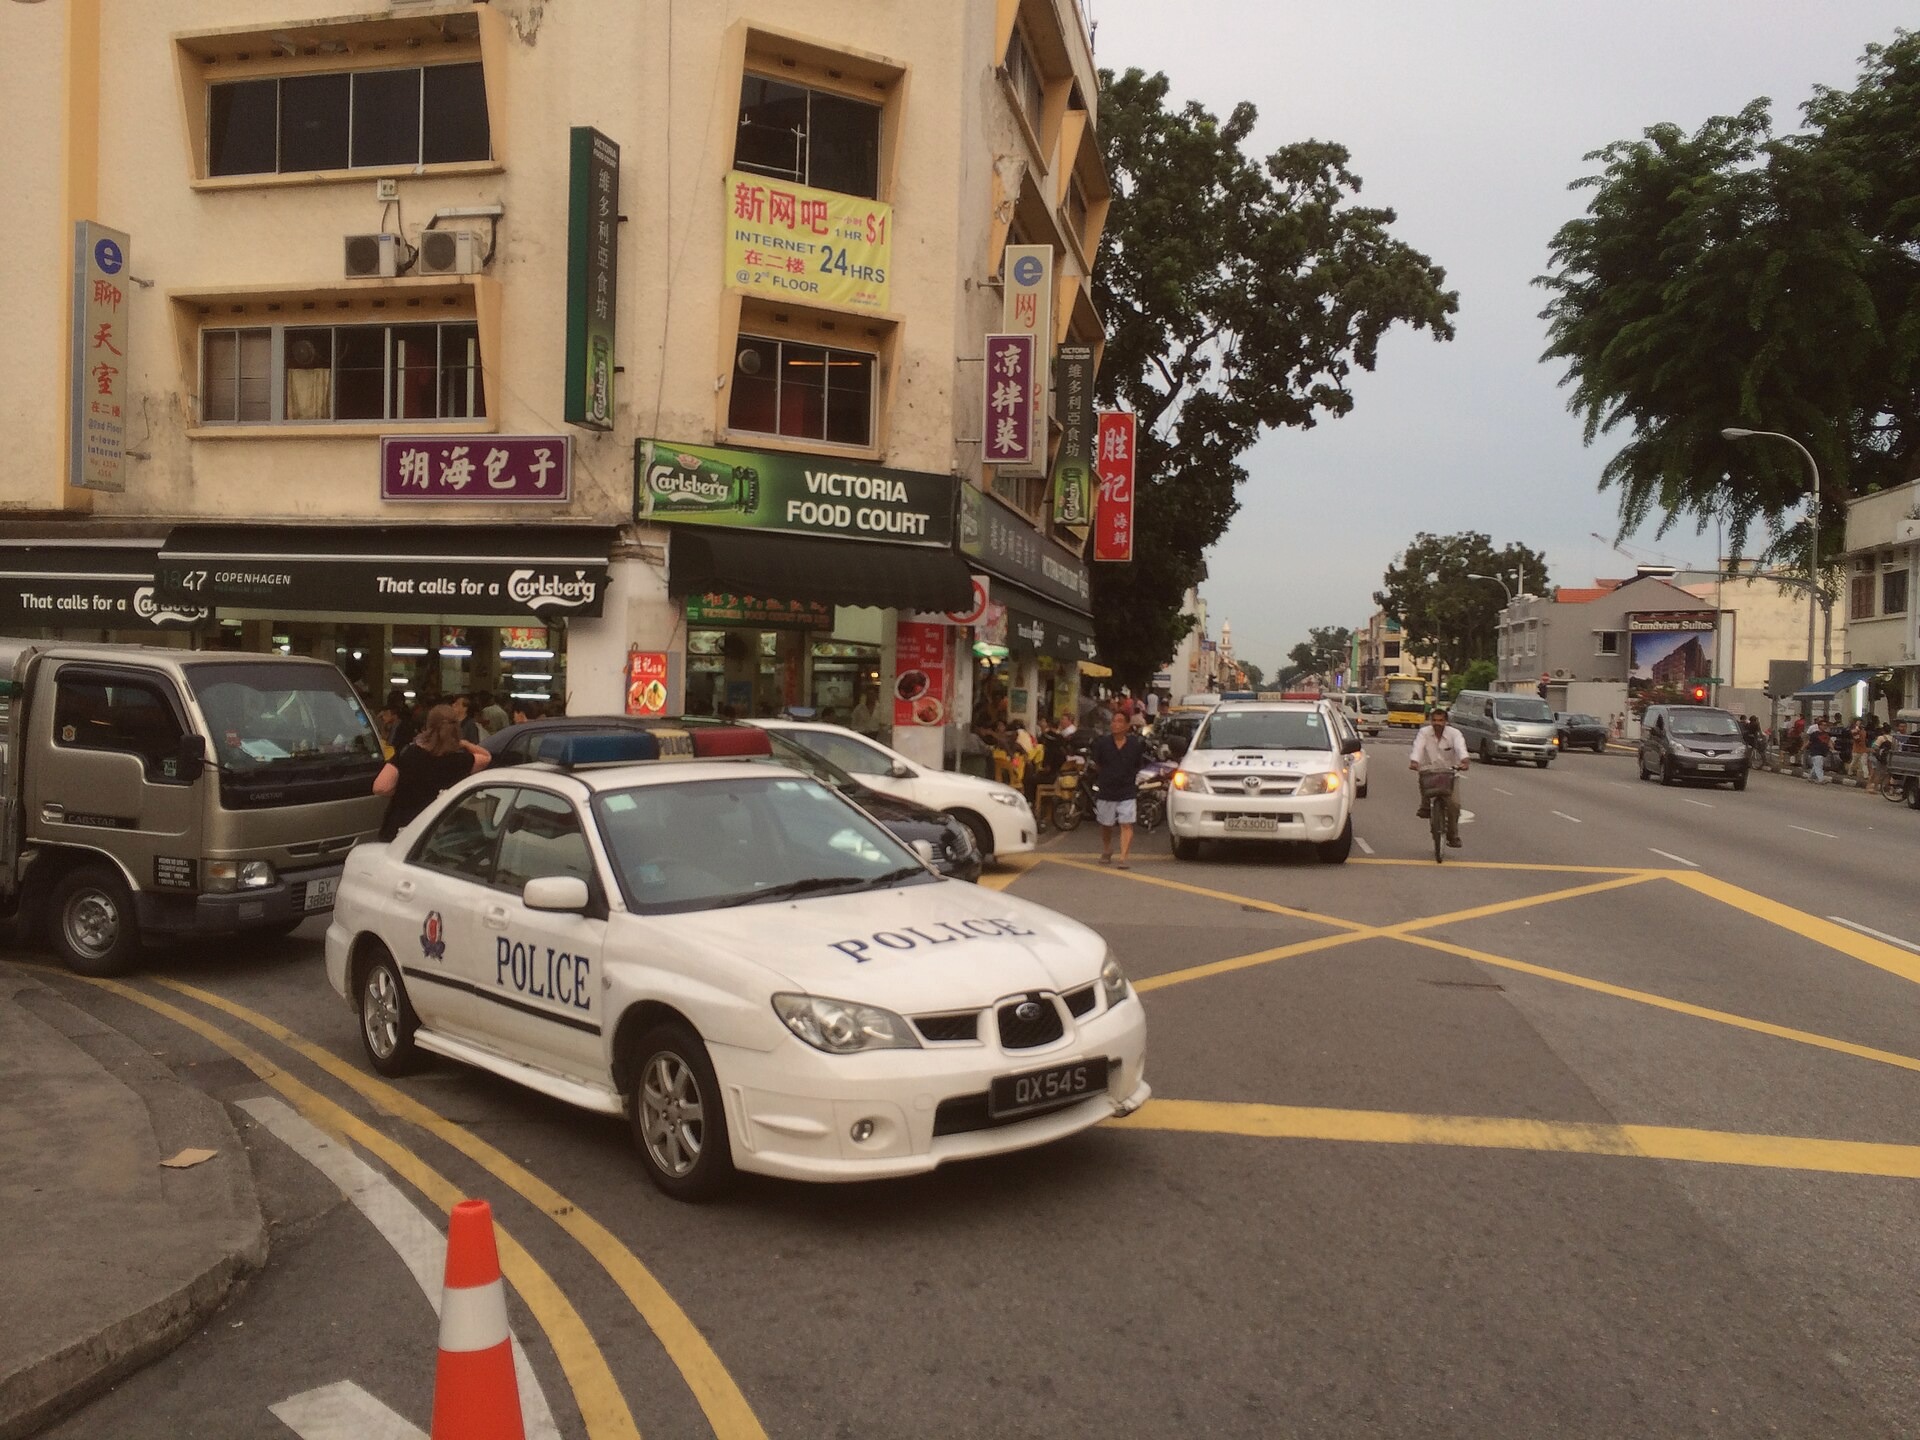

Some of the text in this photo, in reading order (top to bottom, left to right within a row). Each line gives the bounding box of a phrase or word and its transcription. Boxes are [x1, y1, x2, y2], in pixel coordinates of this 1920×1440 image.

[734, 181, 829, 236] 新网吧
[735, 229, 817, 255] INTERNET
[835, 228, 862, 241] 1 HR
[866, 211, 886, 246] $1
[744, 248, 806, 275] 在二楼
[819, 245, 886, 284] 24 HRS
[736, 269, 750, 284] @
[773, 275, 819, 294] FLOOR
[92, 278, 122, 396] 聊天室
[399, 446, 557, 491] 朔海包子
[1100, 425, 1130, 504] 胜记
[650, 464, 729, 502] Carlsberg
[804, 470, 909, 504] VICTORIA
[786, 500, 852, 528] FOOD
[855, 507, 931, 536] COURT
[214, 571, 292, 585] COPENHAGEN
[376, 569, 597, 609] That calls for a Carlsberg
[20, 593, 53, 610] That
[56, 594, 89, 610] calls
[92, 595, 113, 611] for
[117, 599, 126, 611] a
[1631, 620, 1713, 631] Grandview Suites
[1211, 759, 1300, 769] POLICE
[827, 917, 1036, 963] POLICE
[495, 935, 592, 1011] POLICE
[1015, 1066, 1088, 1103] QX54S
